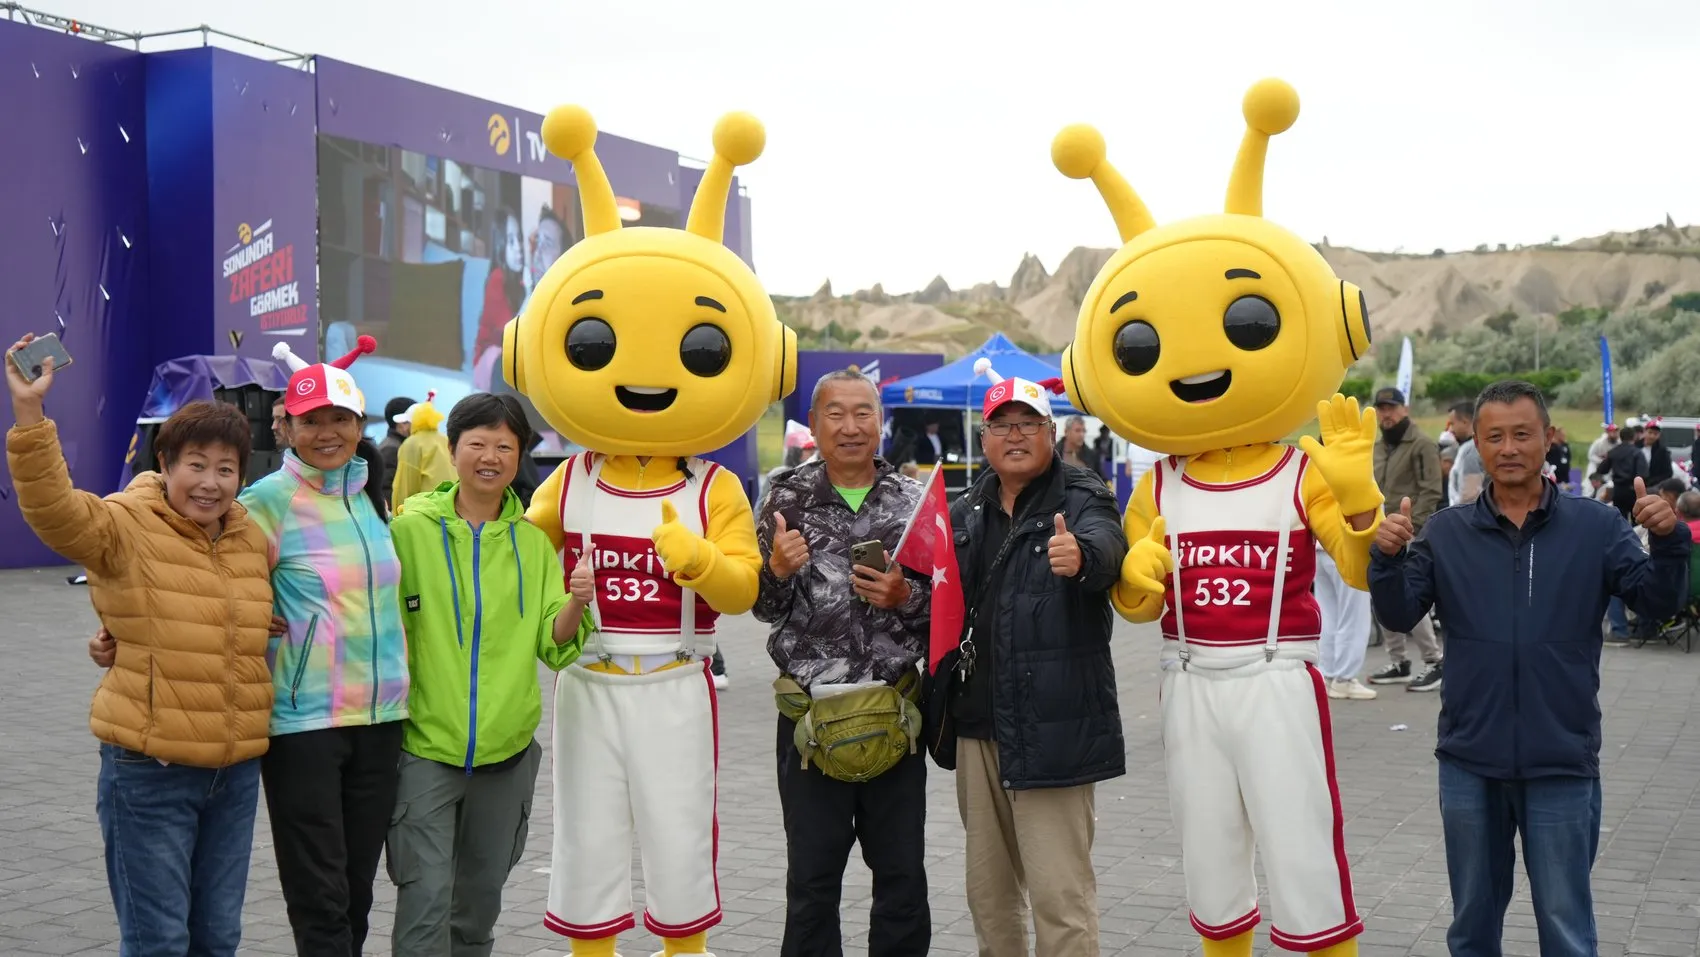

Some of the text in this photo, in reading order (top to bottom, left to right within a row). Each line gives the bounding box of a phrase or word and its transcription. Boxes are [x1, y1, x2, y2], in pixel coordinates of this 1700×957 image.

[223, 232, 273, 278] SONUNDA
[230, 243, 293, 304] ZAFERİ
[250, 281, 299, 316] GÖRMEK
[1178, 540, 1294, 572] ÜRKİYE
[606, 577, 661, 602] 532
[1194, 577, 1251, 606] 532
